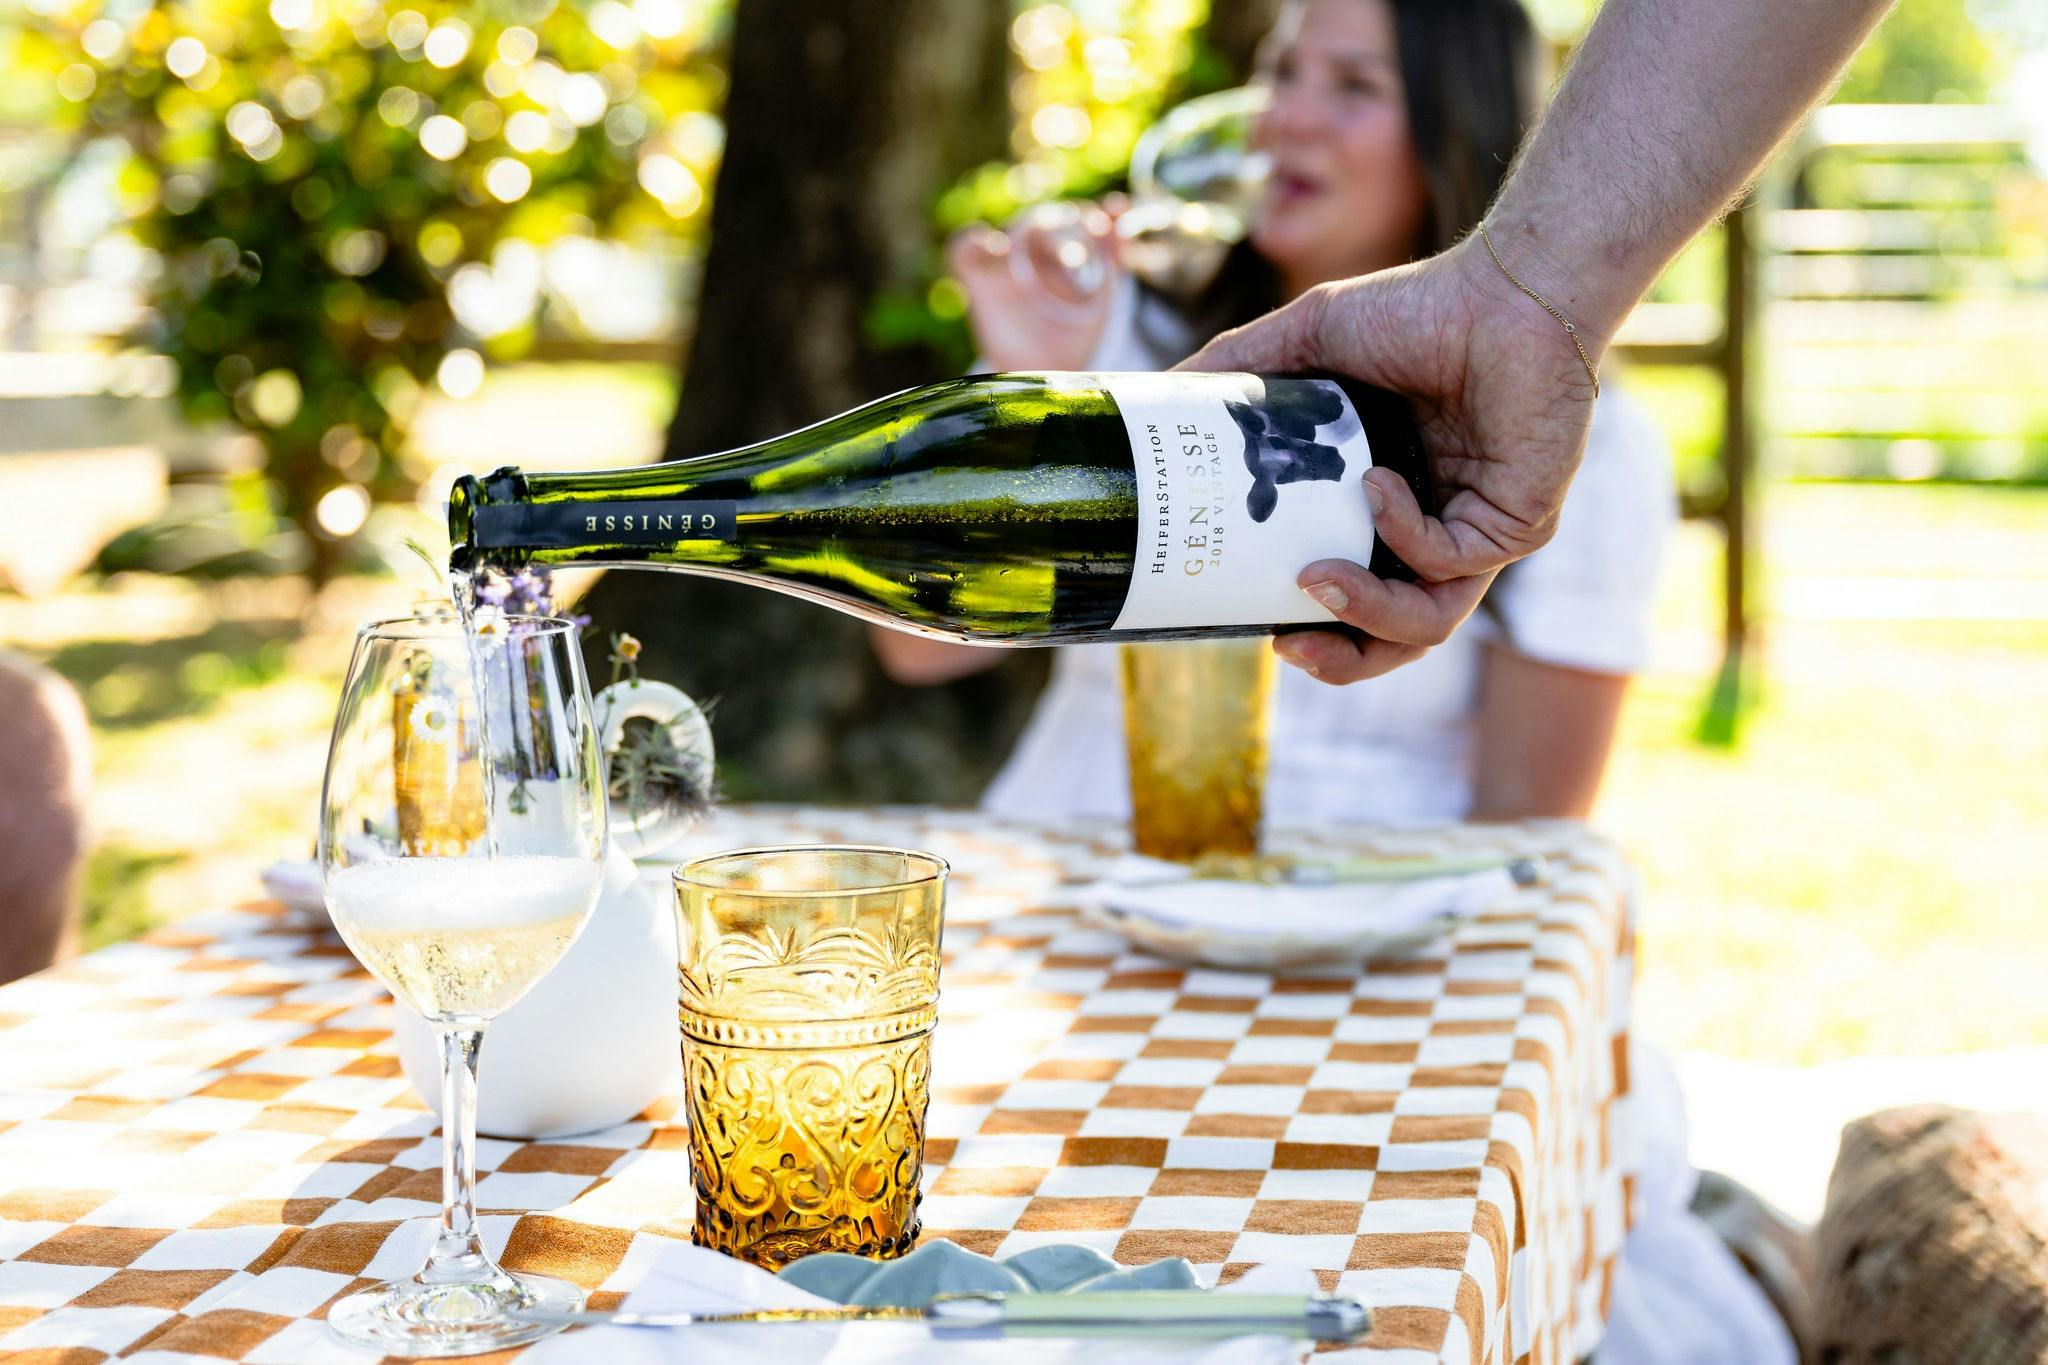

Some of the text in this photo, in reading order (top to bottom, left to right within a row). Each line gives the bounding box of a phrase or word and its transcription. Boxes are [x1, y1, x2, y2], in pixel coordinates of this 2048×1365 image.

[585, 514, 716, 533] GÉNISSE
[1177, 424, 1209, 576] GÉNISSE
[1204, 432, 1225, 567] 2018 VINTAGE
